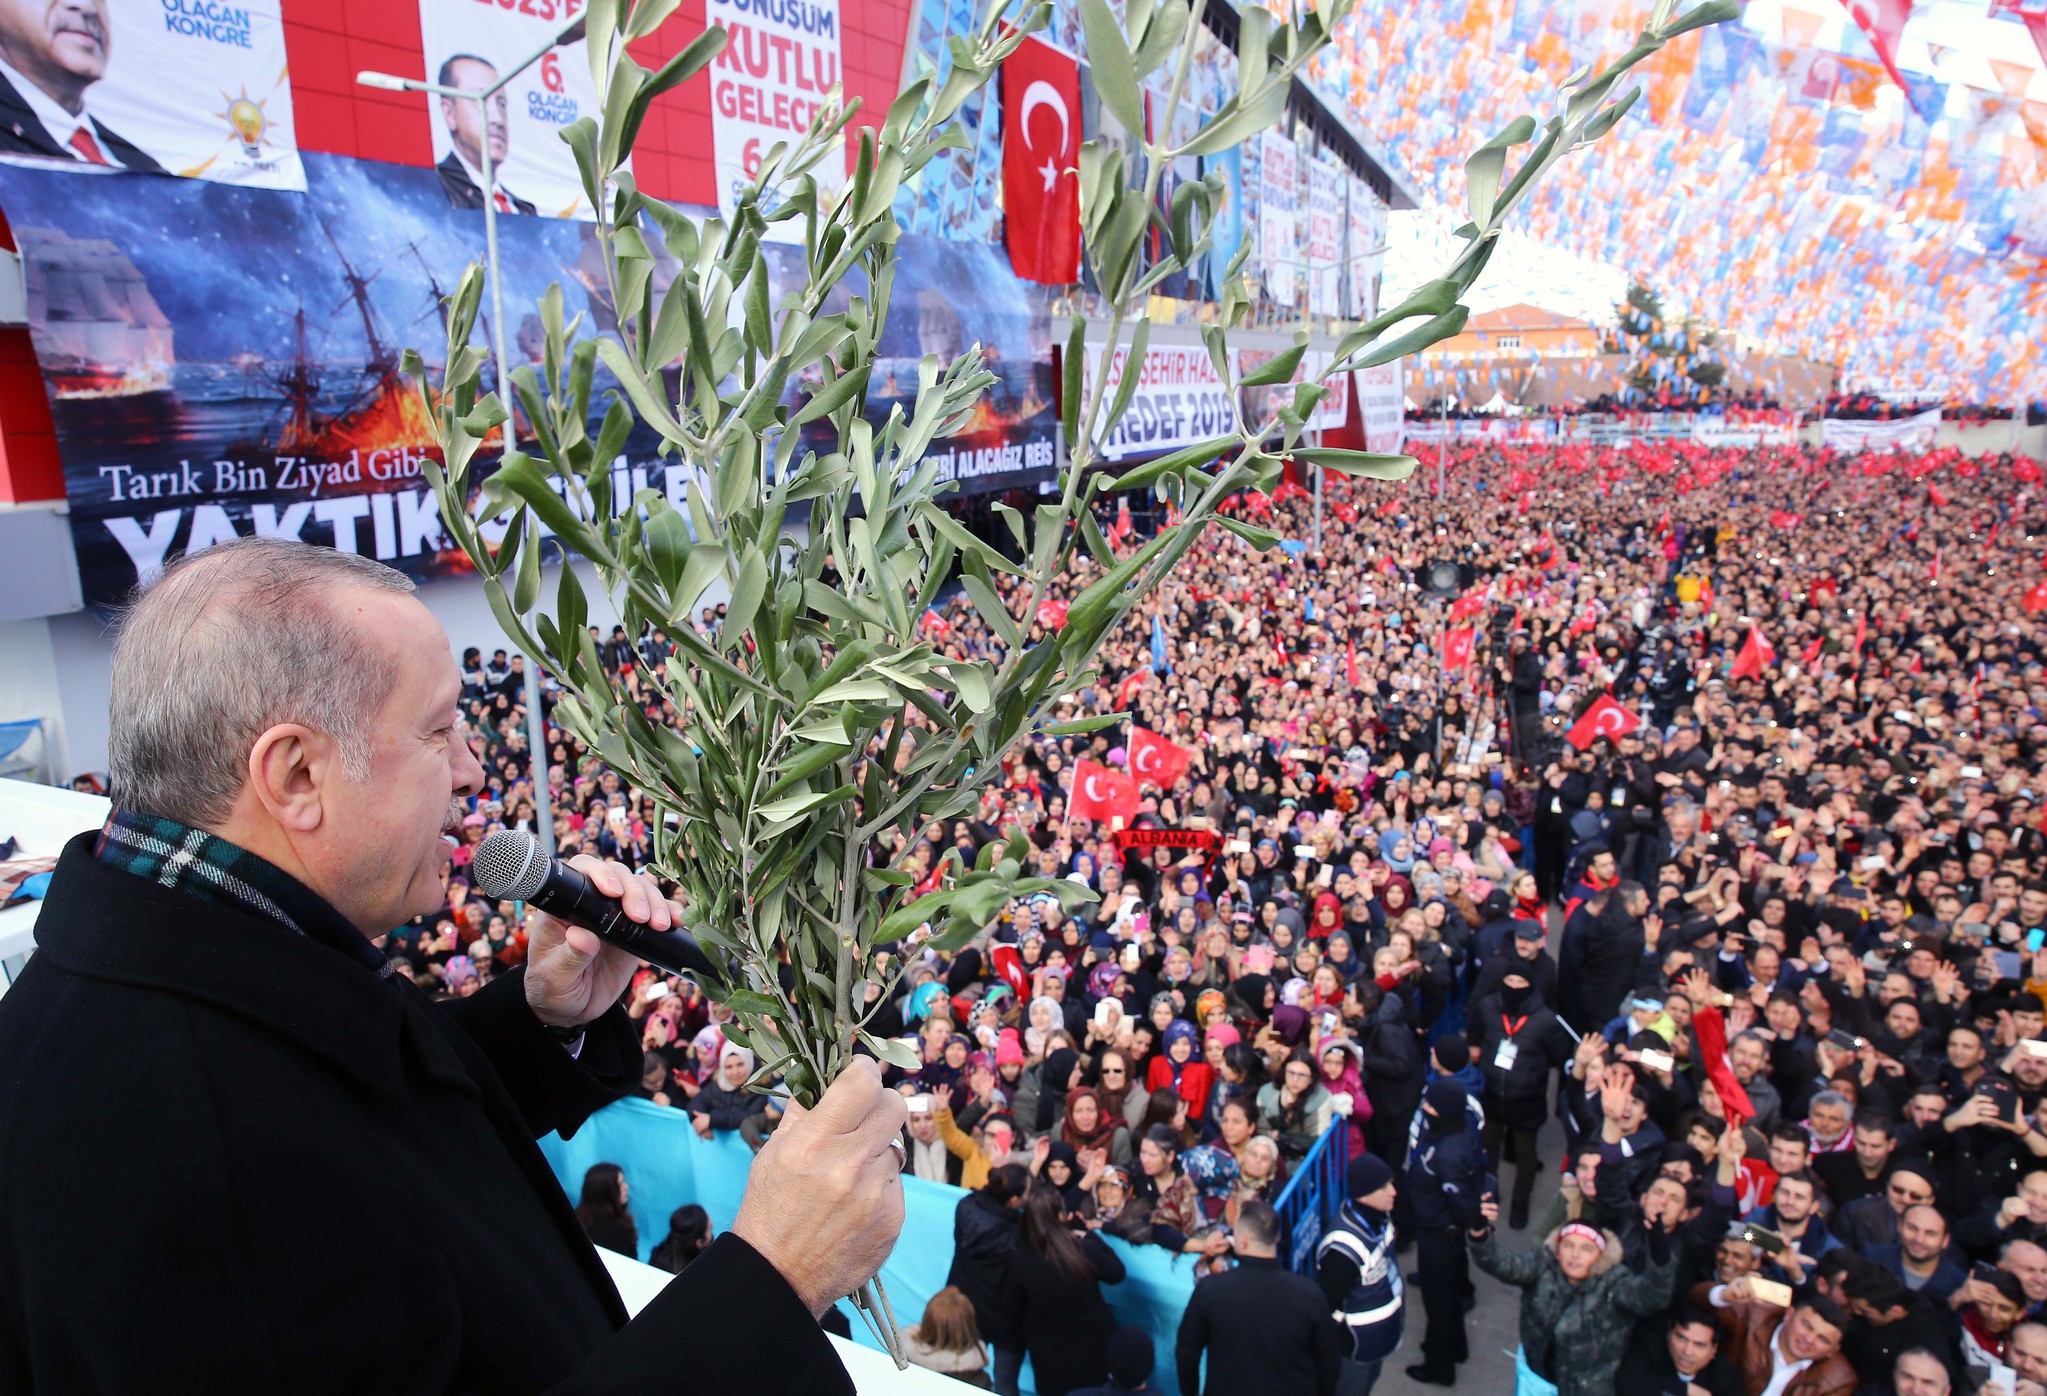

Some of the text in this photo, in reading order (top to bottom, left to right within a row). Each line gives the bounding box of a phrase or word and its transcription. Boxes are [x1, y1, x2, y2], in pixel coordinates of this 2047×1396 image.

[164, 12, 253, 49] KONGRE
[714, 16, 836, 95] KUTLU
[1103, 392, 1233, 446] HEDEF 2019
[99, 459, 202, 501] Tarık
[213, 460, 268, 493] Bin
[274, 449, 361, 497] Ziyad
[957, 441, 1024, 479] ALACAĞIZ
[1024, 436, 1054, 469] REİS
[1130, 831, 1199, 847] ALBANIA
